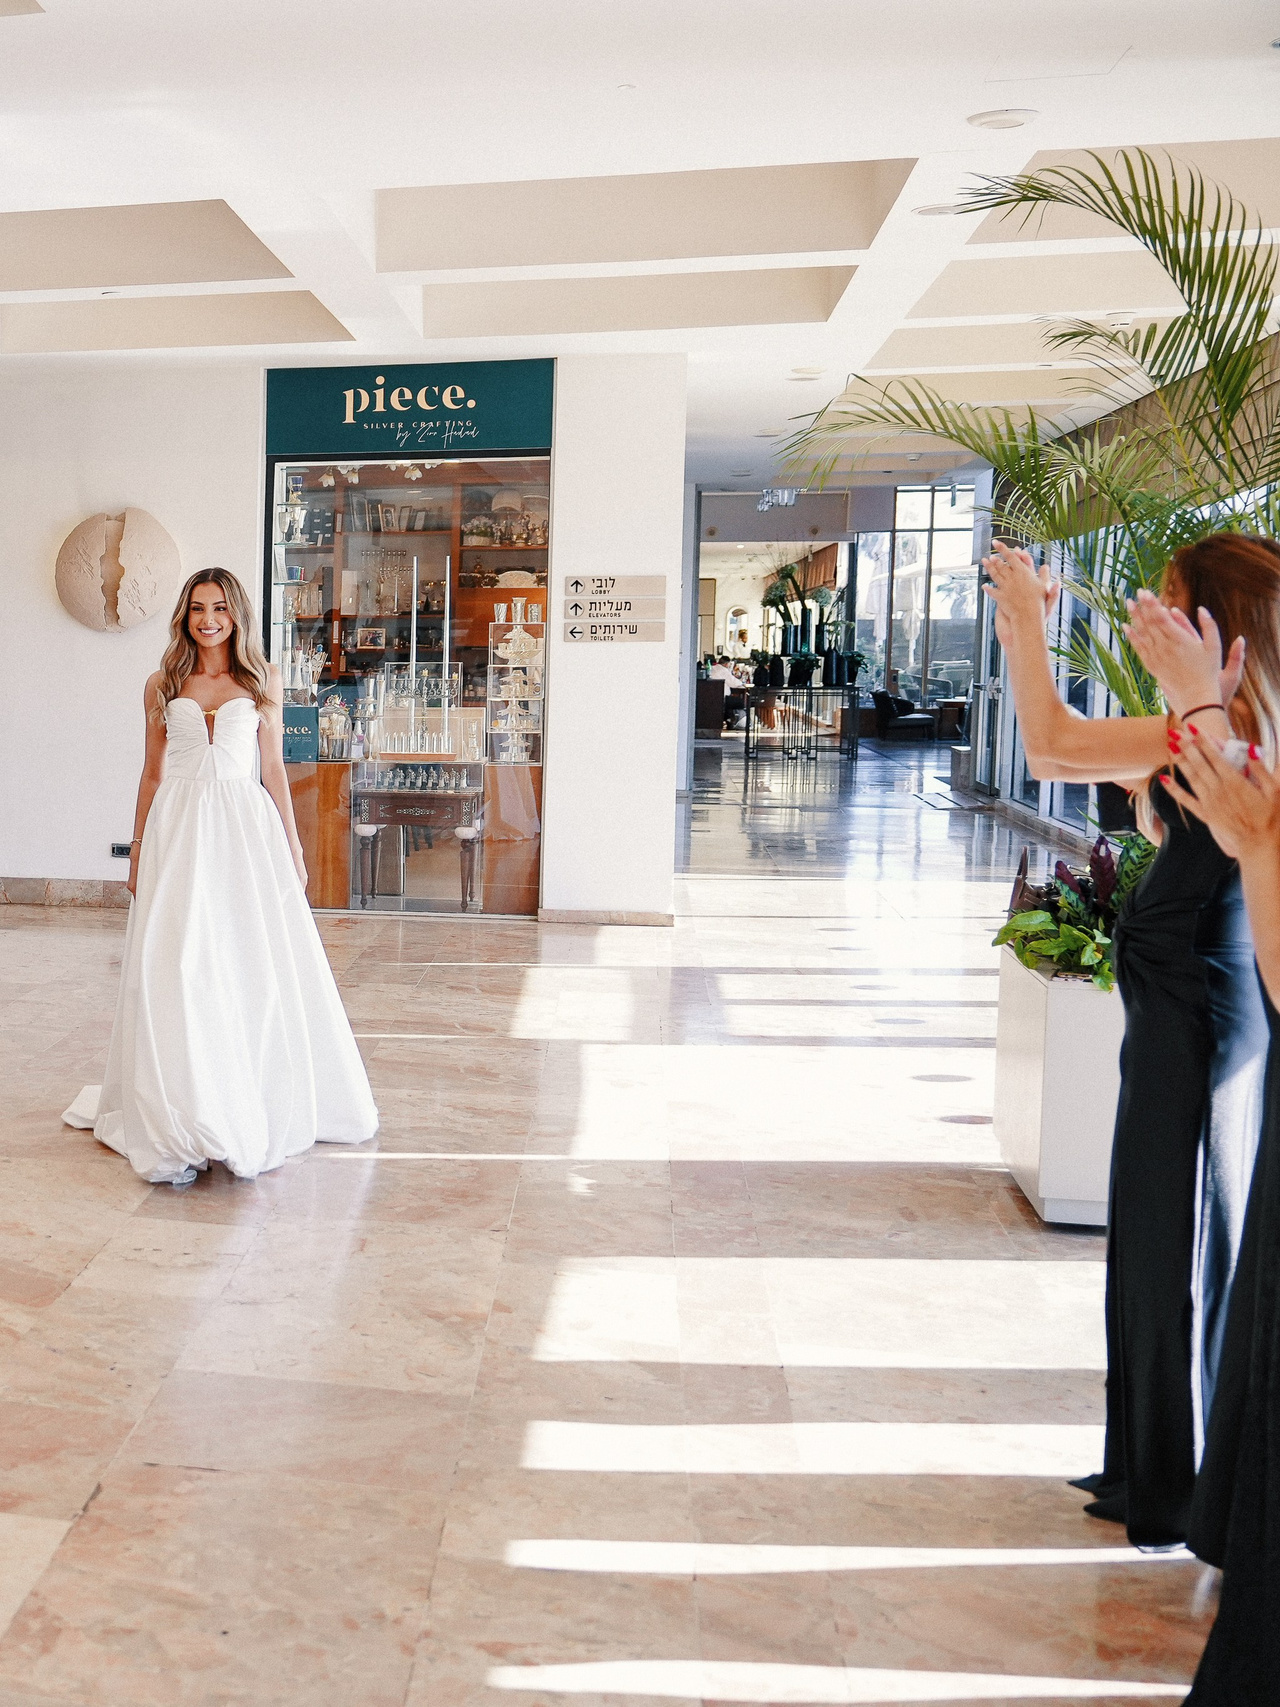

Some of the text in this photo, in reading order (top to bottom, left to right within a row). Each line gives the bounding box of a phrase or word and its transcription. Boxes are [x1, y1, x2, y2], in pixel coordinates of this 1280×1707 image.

[342, 375, 477, 424] piece.
[412, 420, 472, 428] CRAFTING
[591, 576, 616, 588] לובי
[588, 600, 632, 612] מעליות
[590, 624, 638, 635] שירותים
[282, 723, 312, 735] iece.
